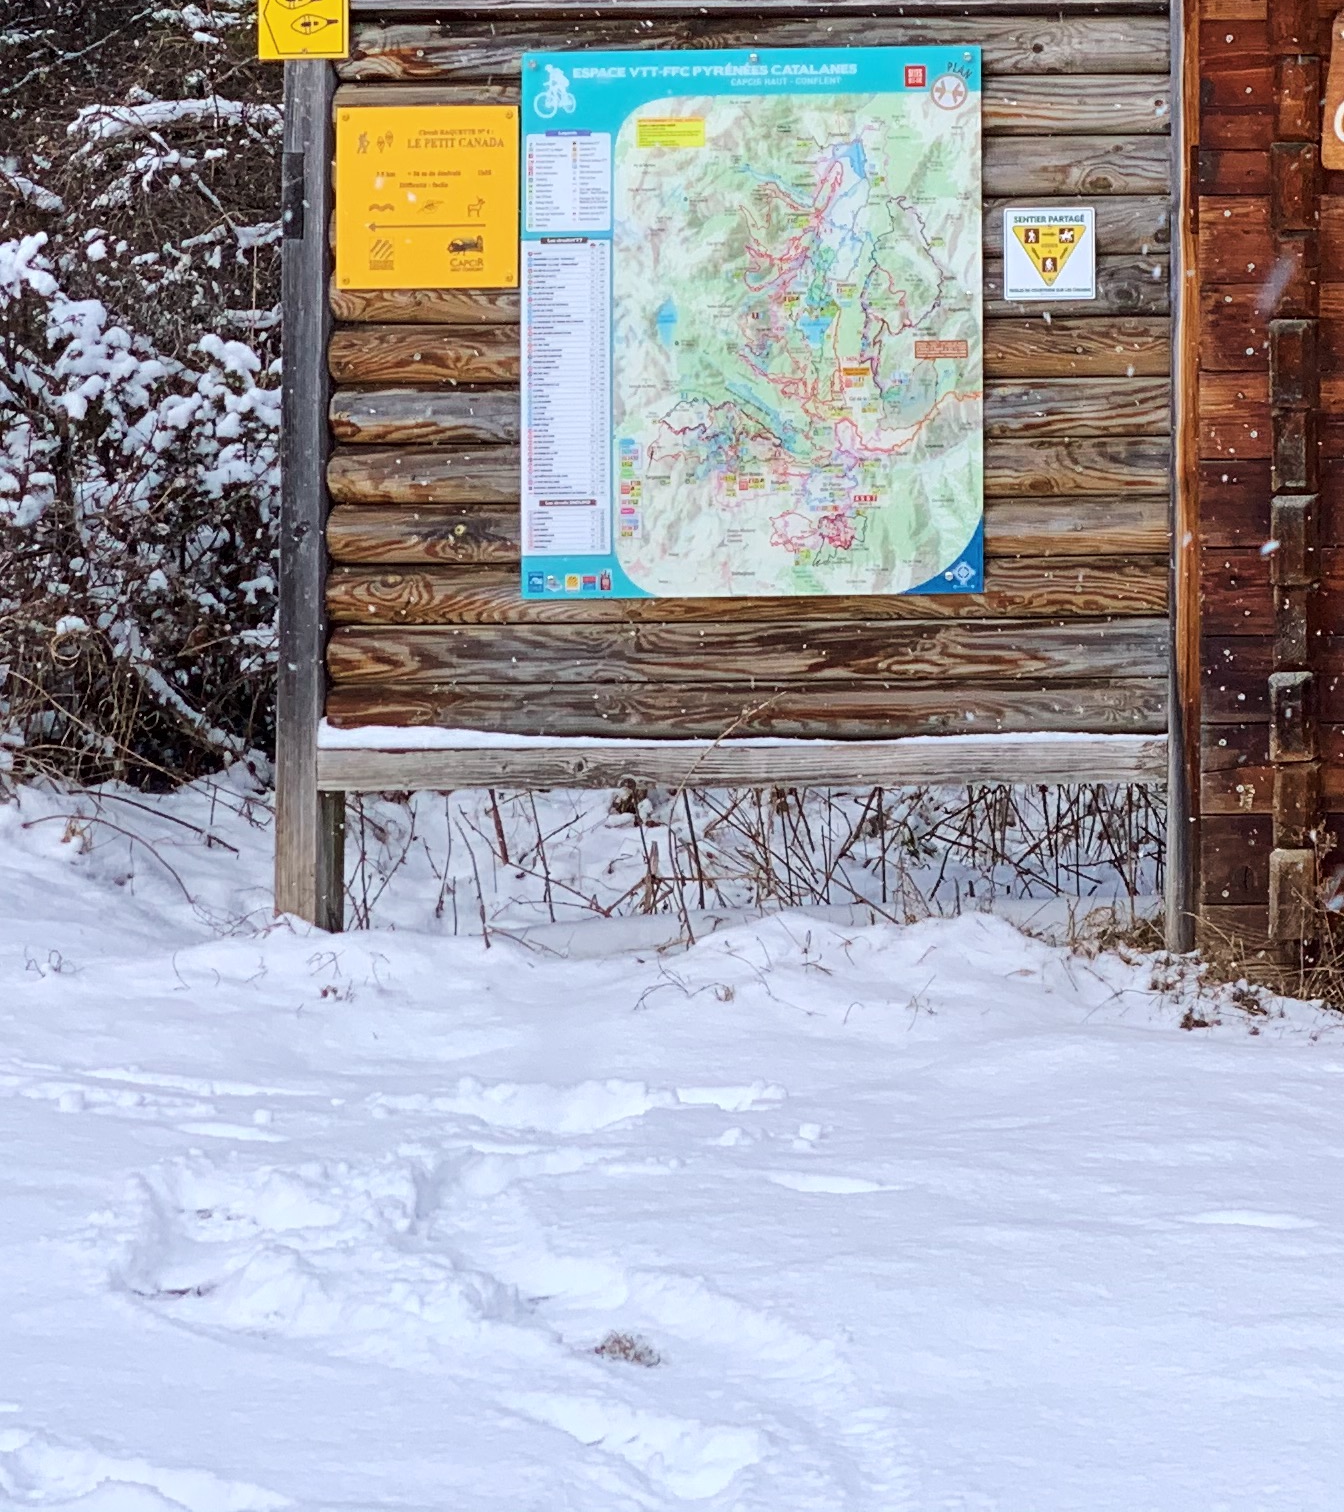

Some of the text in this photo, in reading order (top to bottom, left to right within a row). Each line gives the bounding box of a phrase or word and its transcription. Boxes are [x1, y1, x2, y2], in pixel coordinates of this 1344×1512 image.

[572, 62, 858, 78] ESPACE VTT-FFC PYRÉNÉES CATALANES
[947, 61, 972, 79] PLAN
[407, 137, 504, 148] LE PETIT CANADA
[1014, 214, 1085, 224] SENTIER PARTAGÉ
